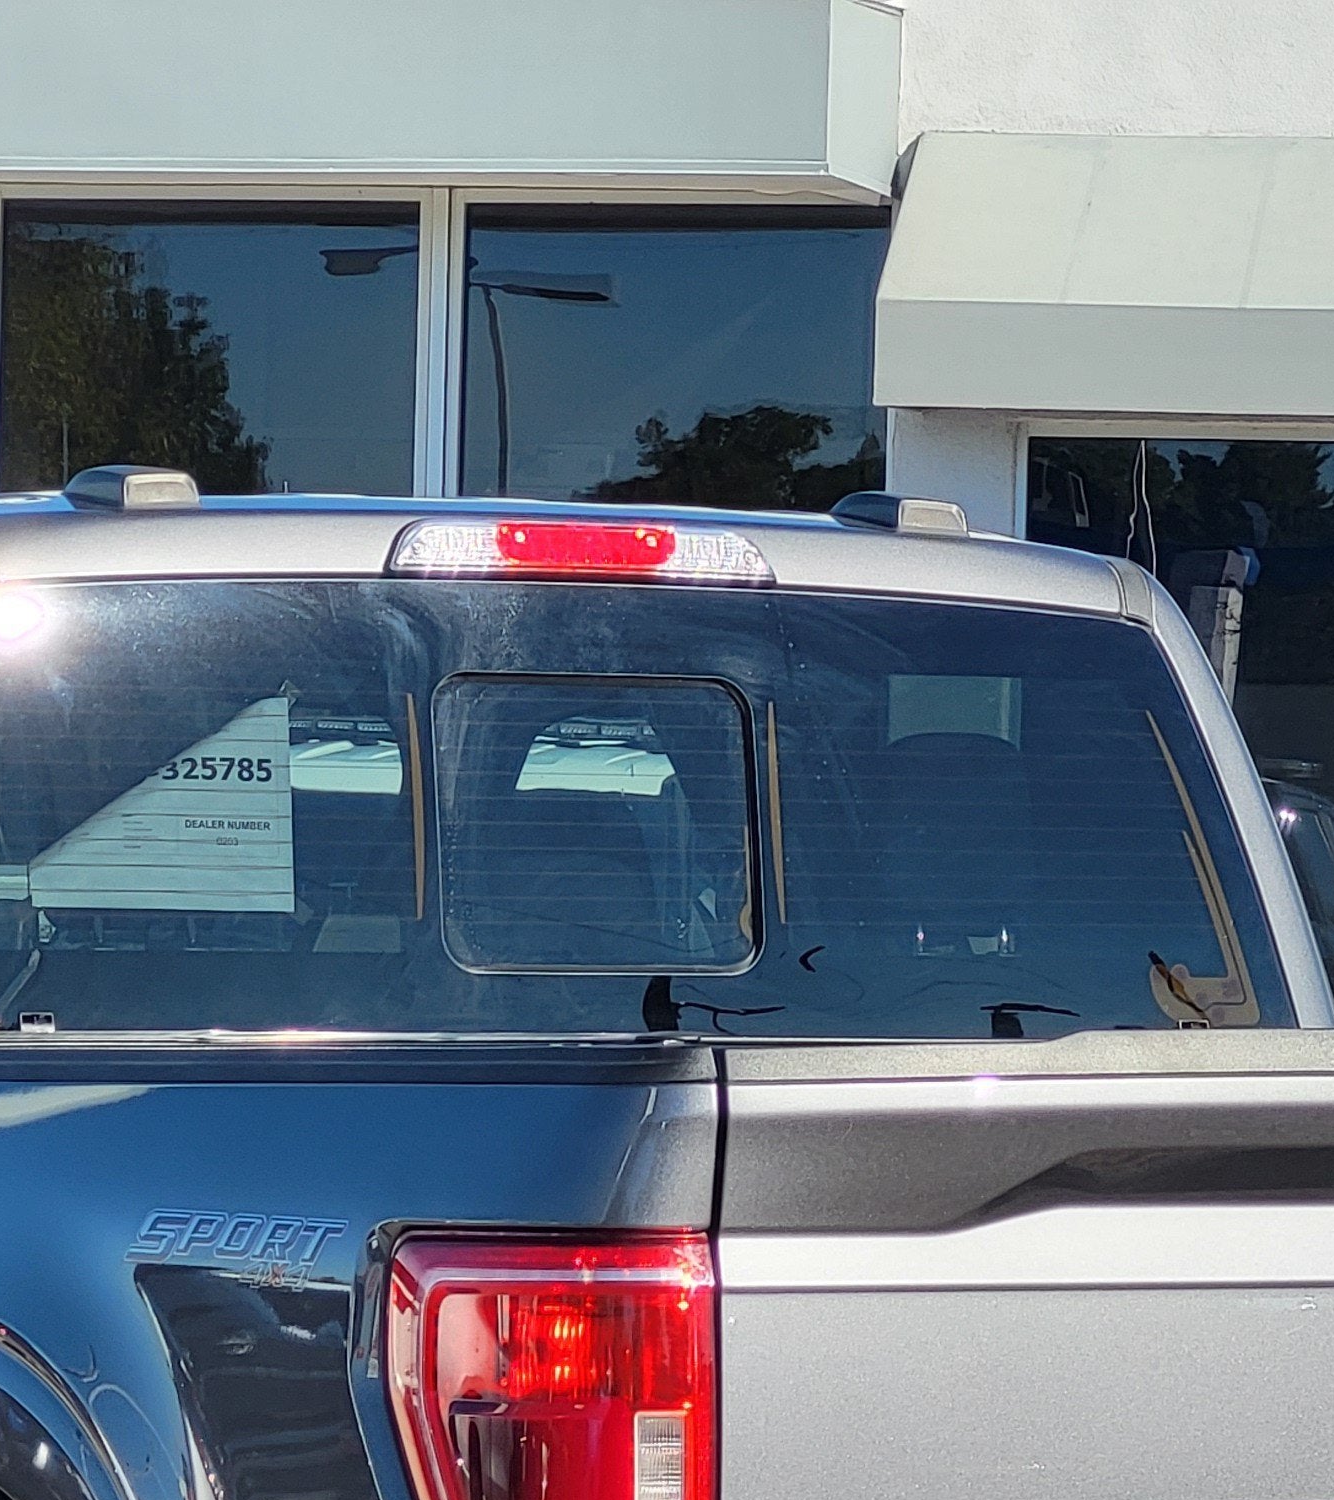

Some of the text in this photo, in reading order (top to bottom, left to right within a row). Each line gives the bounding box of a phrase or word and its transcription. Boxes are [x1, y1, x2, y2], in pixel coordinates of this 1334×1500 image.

[184, 819, 271, 831] DEALER NUMBER
[124, 1208, 349, 1265] SPORT
